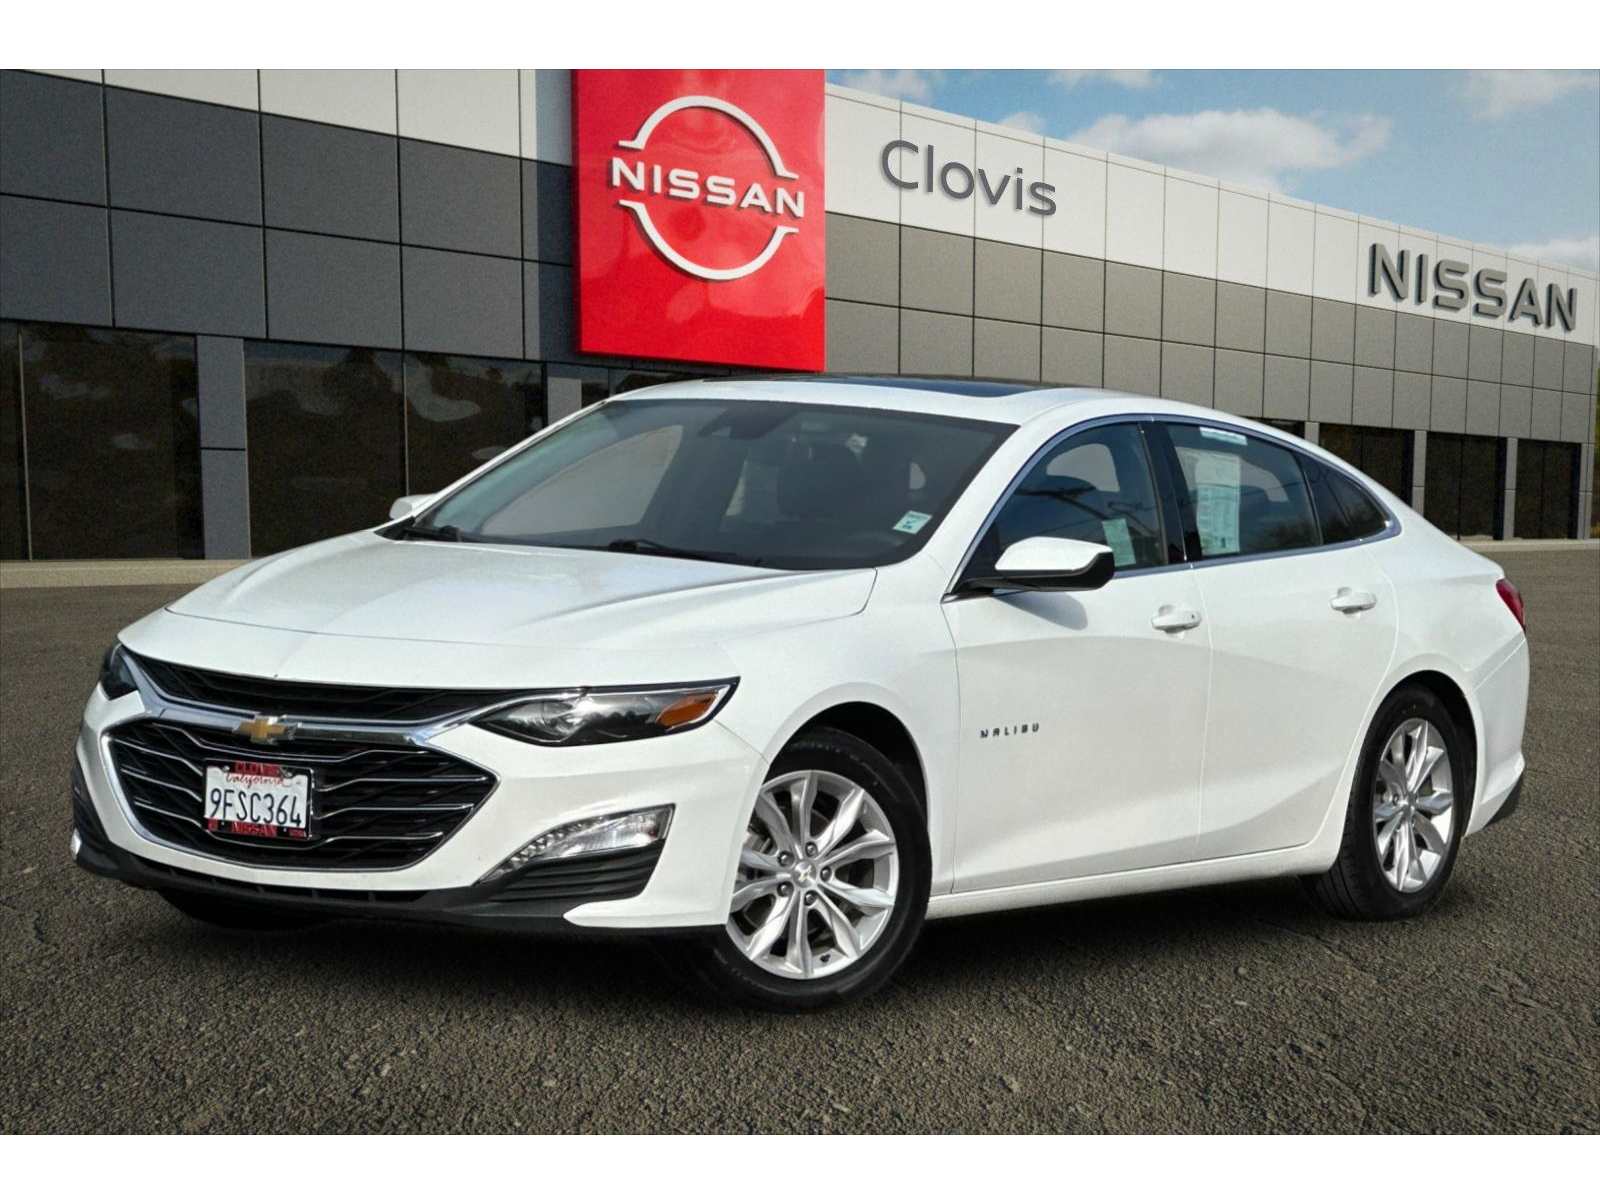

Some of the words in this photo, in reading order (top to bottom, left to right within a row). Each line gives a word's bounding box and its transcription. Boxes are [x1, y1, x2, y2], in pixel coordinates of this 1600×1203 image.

[611, 156, 805, 218] NISSAN
[882, 139, 1057, 216] Clovis
[1368, 243, 1578, 332] NISSAN
[210, 787, 302, 827] 9FSC364
